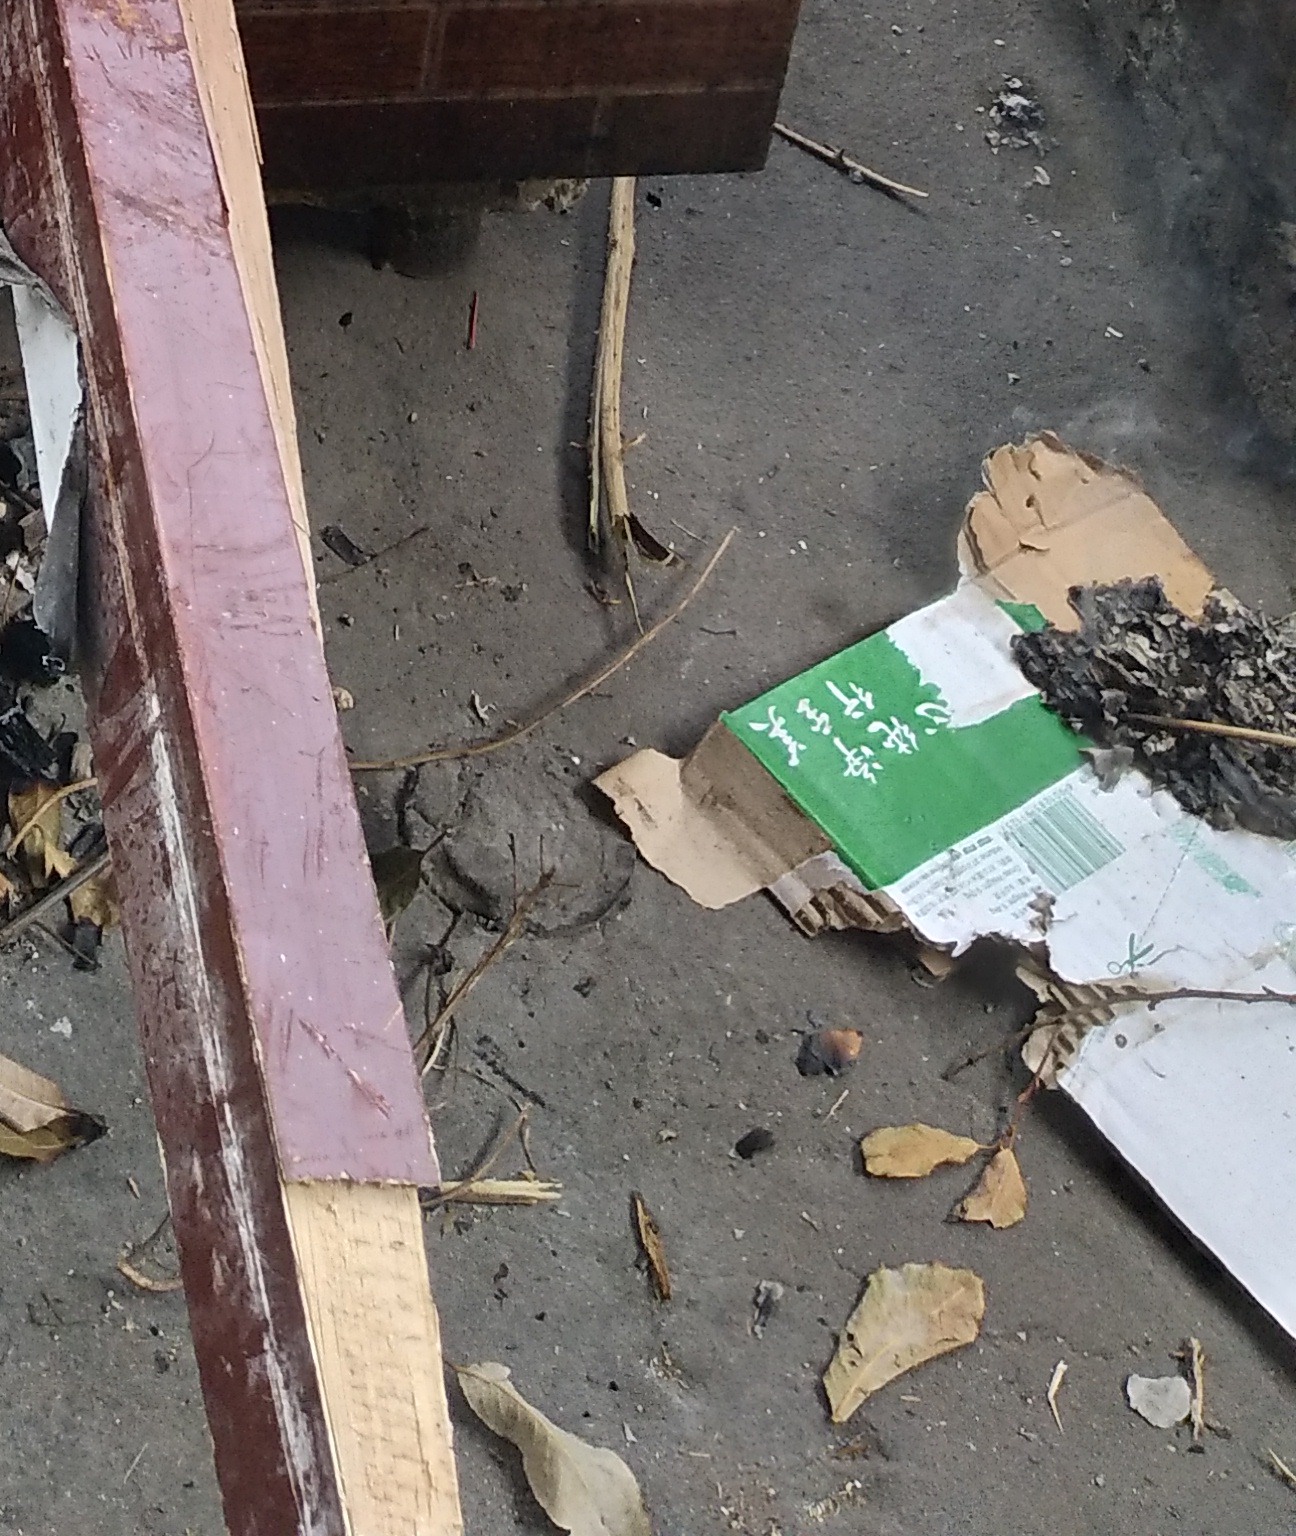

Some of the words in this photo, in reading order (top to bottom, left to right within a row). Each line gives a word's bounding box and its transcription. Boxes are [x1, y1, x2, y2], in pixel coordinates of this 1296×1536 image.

[748, 680, 875, 767] 行至美
[833, 702, 952, 784] 心纯净
